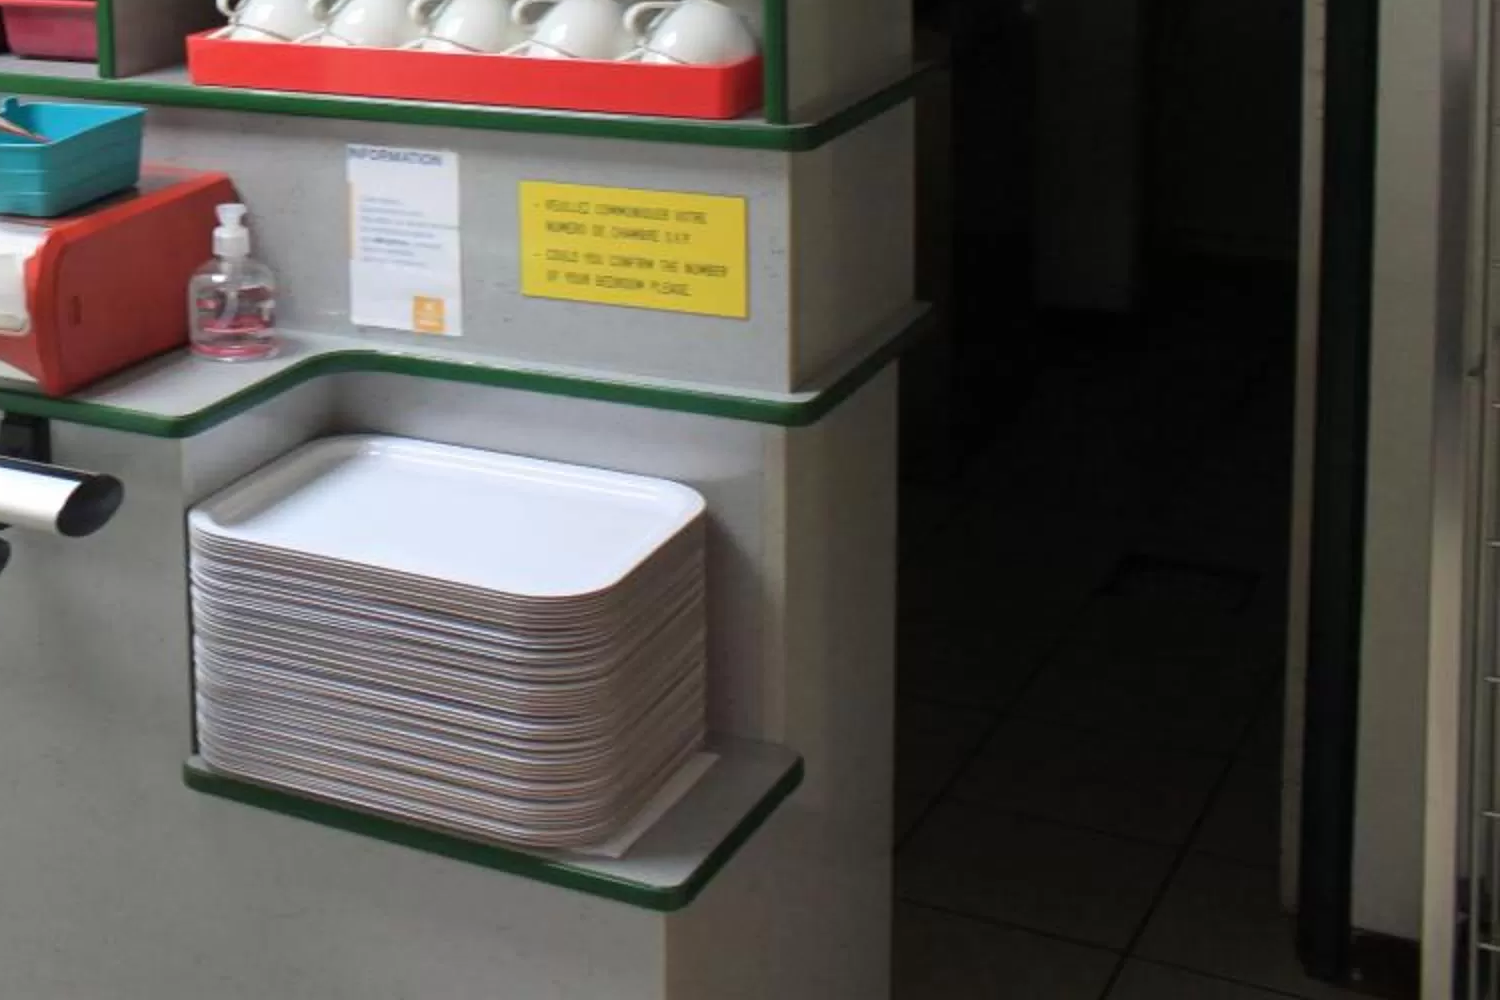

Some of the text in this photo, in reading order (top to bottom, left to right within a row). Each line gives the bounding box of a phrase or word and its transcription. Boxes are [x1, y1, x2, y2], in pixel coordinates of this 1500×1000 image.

[545, 248, 580, 263] COULD
[584, 251, 604, 266] YOU
[609, 255, 655, 270] CONFIRM
[660, 259, 679, 273] THE
[684, 263, 730, 279] NUMBER
[564, 271, 591, 285] YOUR
